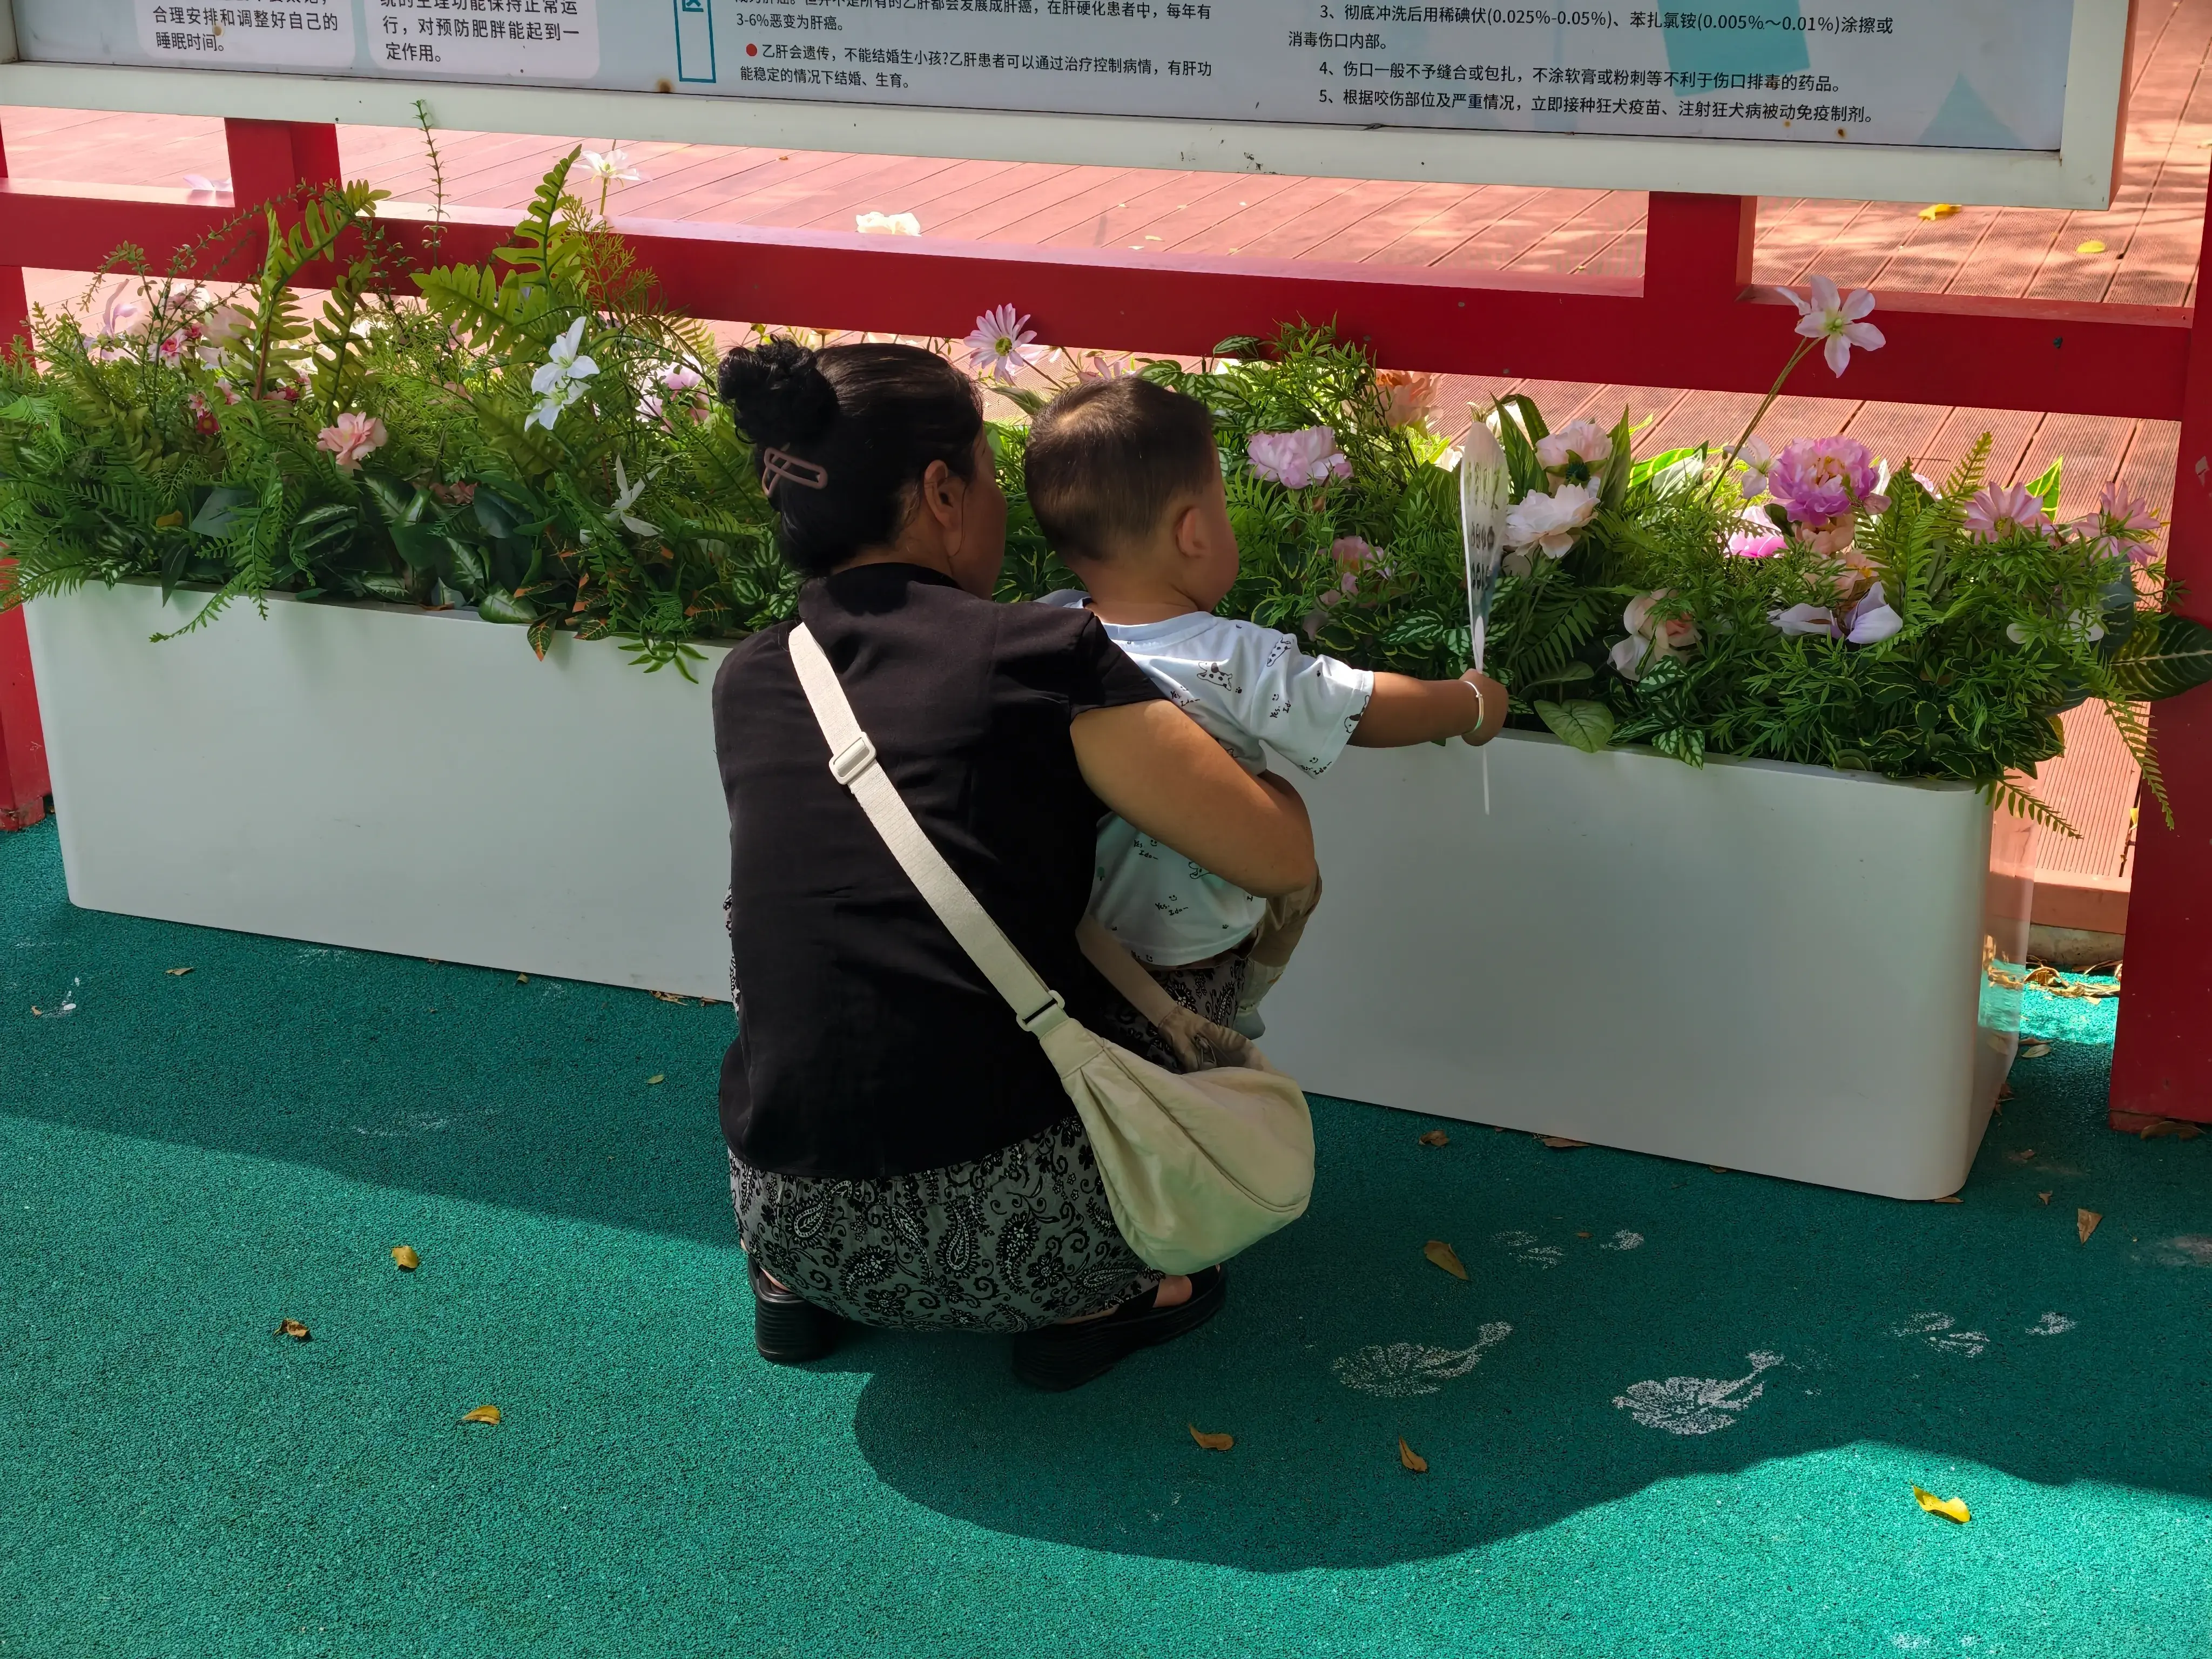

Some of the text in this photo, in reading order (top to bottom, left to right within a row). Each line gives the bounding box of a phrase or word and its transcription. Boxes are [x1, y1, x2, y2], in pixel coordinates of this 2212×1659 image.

[153, 5, 337, 30] 合理安排和调整好自己的
[737, 14, 843, 31] 3-6%恶变为肝癌。
[383, 16, 580, 41] 行，对预防肥胖能起到一
[156, 32, 224, 51] 睡眠时间。
[1289, 31, 1386, 50] 消毒伤口内部。
[386, 43, 441, 62] 定作用。
[740, 66, 908, 89] 能稳定的情况下结婚、生育。
